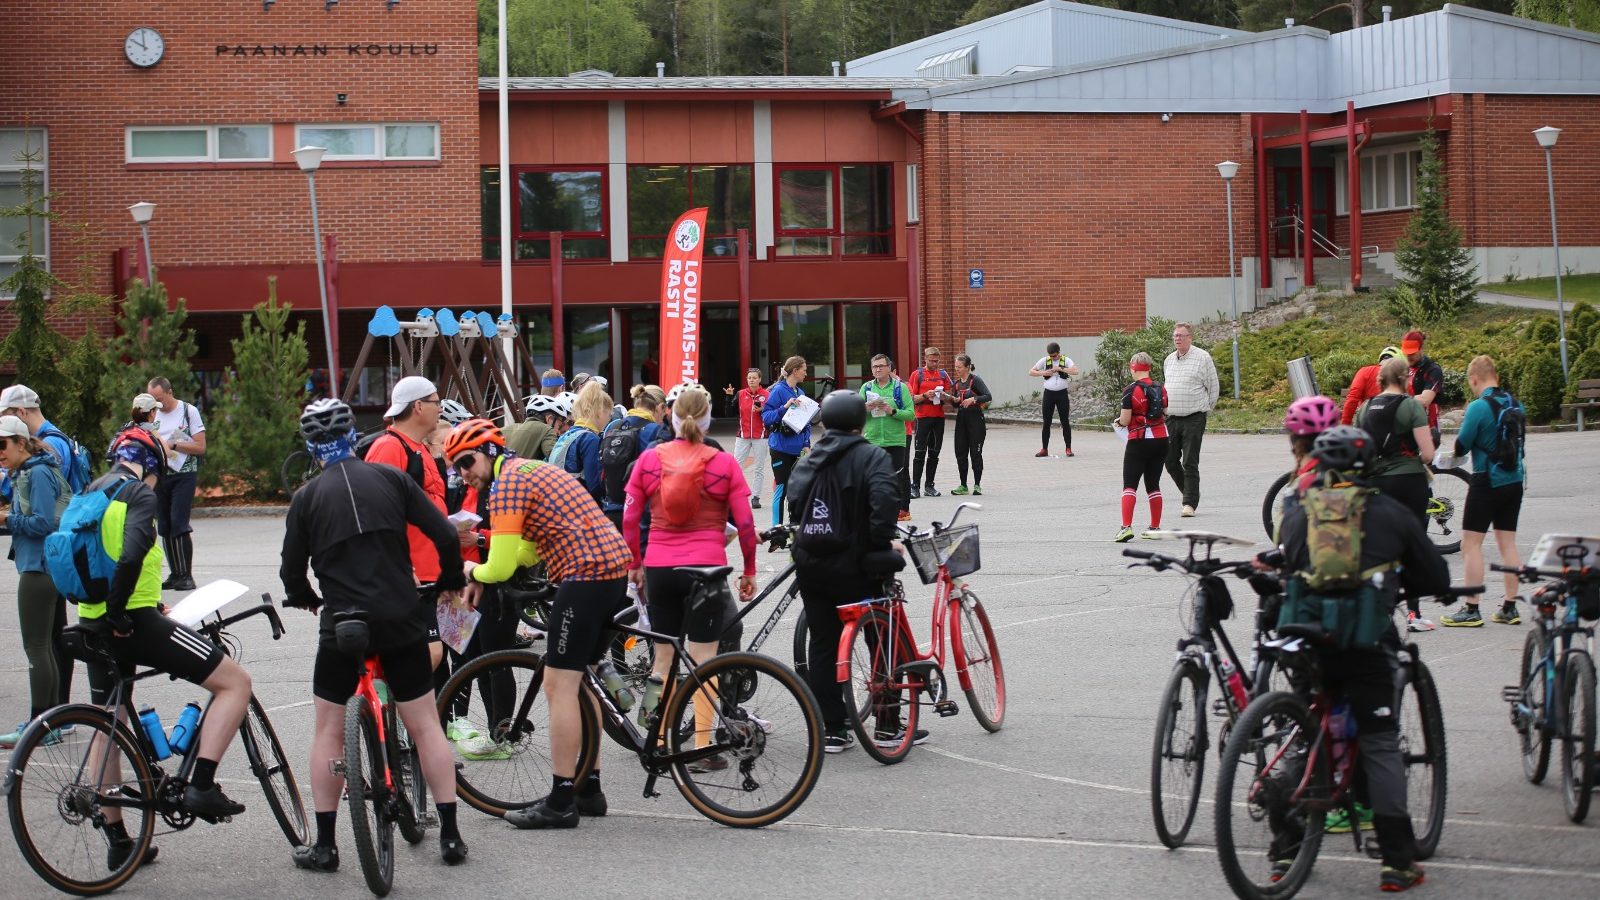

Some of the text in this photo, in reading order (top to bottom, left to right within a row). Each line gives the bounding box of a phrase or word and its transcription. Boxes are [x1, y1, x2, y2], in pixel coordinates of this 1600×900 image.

[215, 44, 438, 56] PAANAN KOULU
[667, 259, 682, 318] RASTI
[803, 523, 833, 535] NEPRA
[558, 617, 571, 655] CRAFT
[751, 593, 793, 653] NAKAMURA
